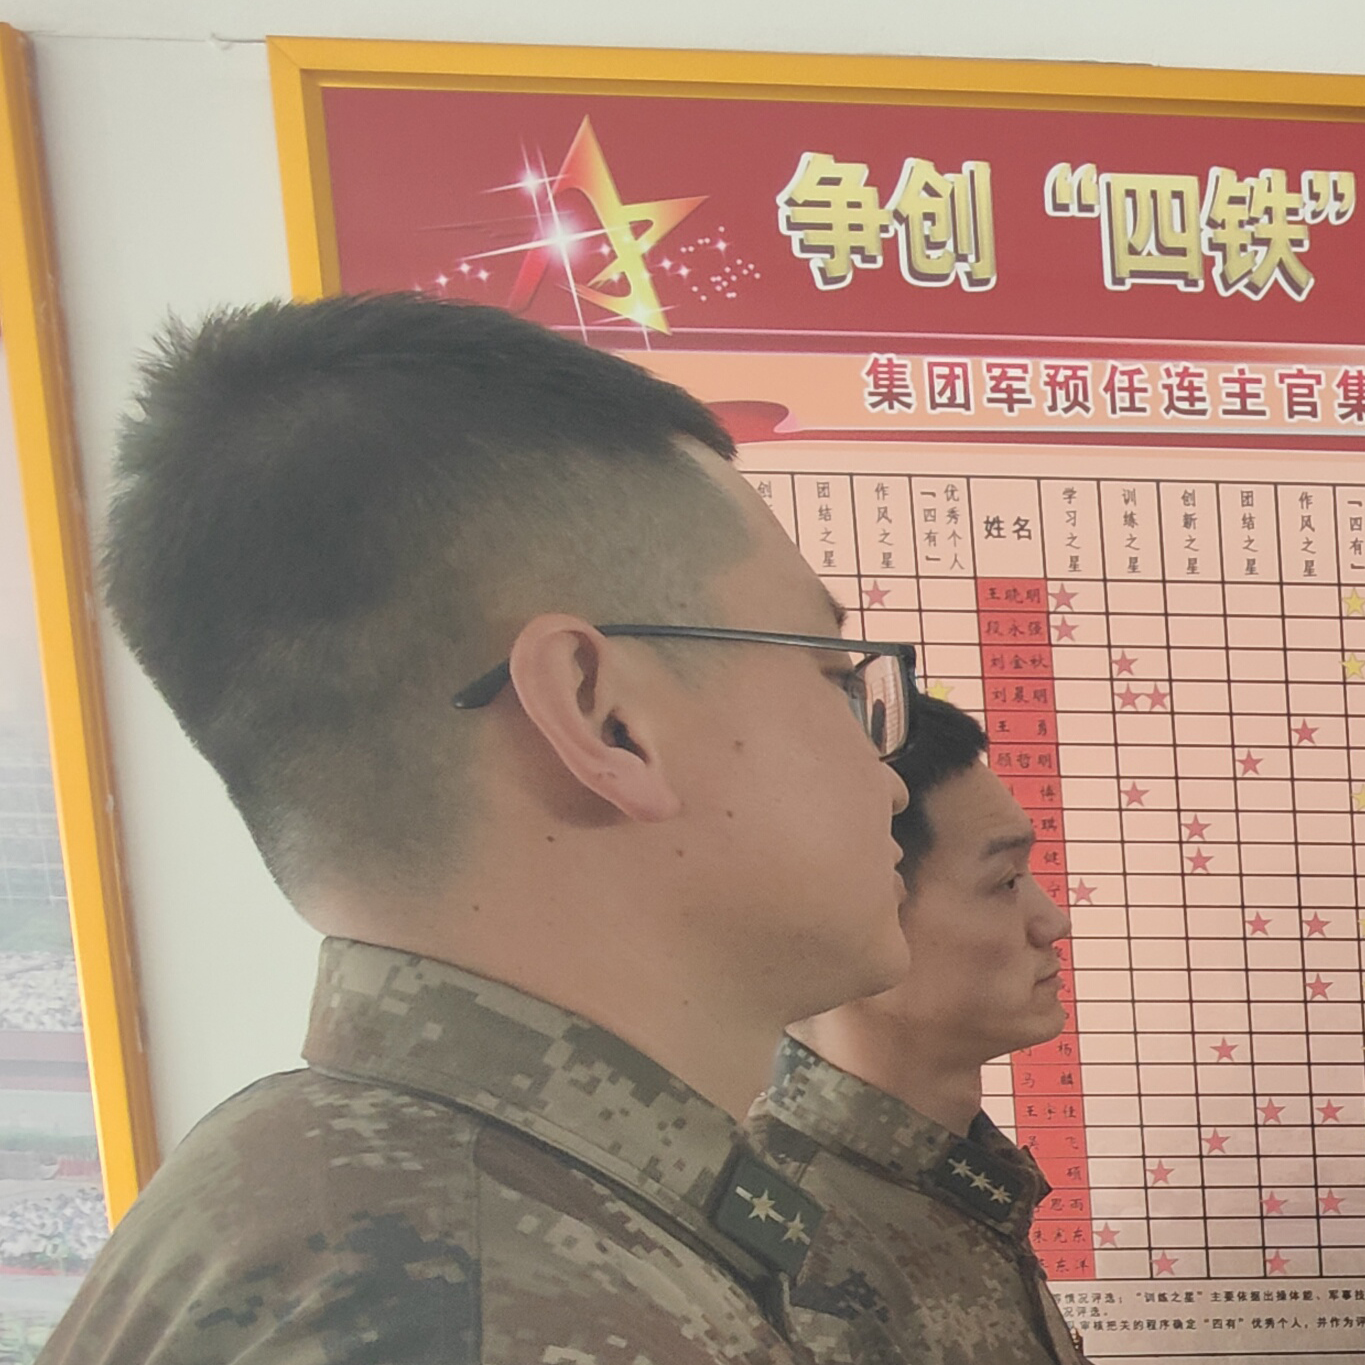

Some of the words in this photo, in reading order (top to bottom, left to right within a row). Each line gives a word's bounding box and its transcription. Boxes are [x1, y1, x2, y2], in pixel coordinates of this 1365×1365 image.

[816, 481, 837, 568] 团结之星
[874, 482, 896, 569] 作风之星
[943, 483, 965, 571] 优秀个人
[983, 515, 1033, 541] 姓名
[1061, 487, 1082, 573] 学习之星
[1121, 488, 1142, 574] 训练之星
[1181, 489, 1201, 576] 创新之星
[1240, 490, 1260, 576] 团结之星
[1298, 491, 1318, 578] 作风之星
